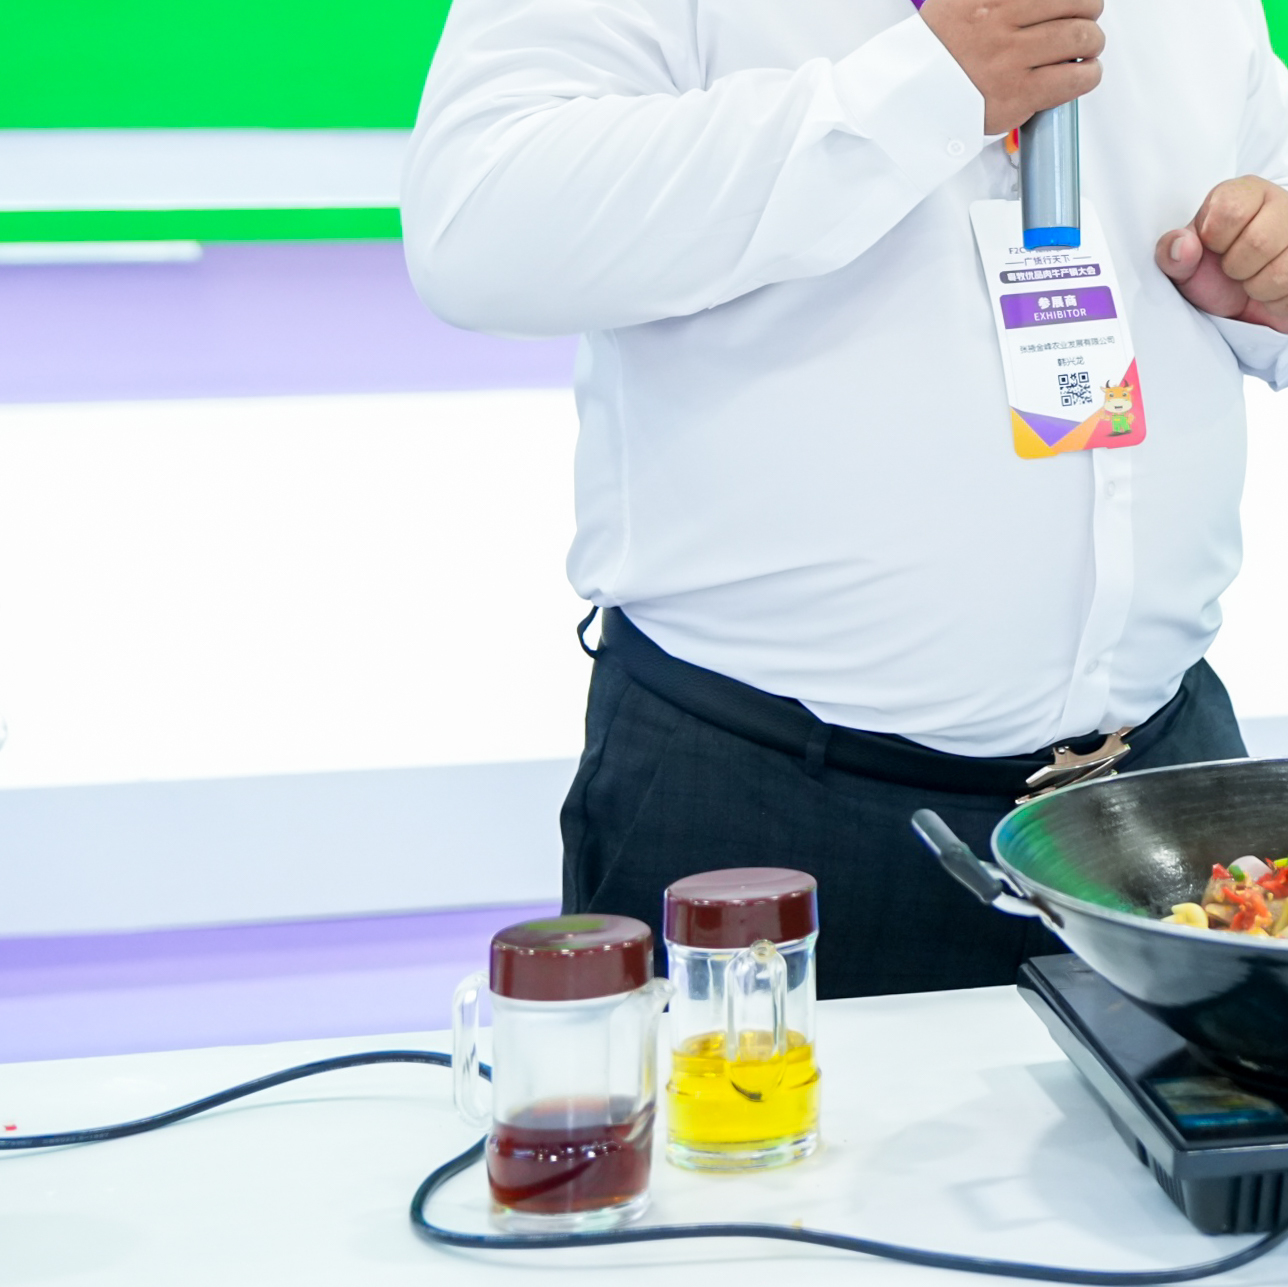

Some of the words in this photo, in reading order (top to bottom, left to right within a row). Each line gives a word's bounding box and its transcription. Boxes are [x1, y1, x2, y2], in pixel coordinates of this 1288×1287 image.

[1038, 294, 1078, 310] 参展商
[1034, 308, 1087, 322] EXHIBITOR
